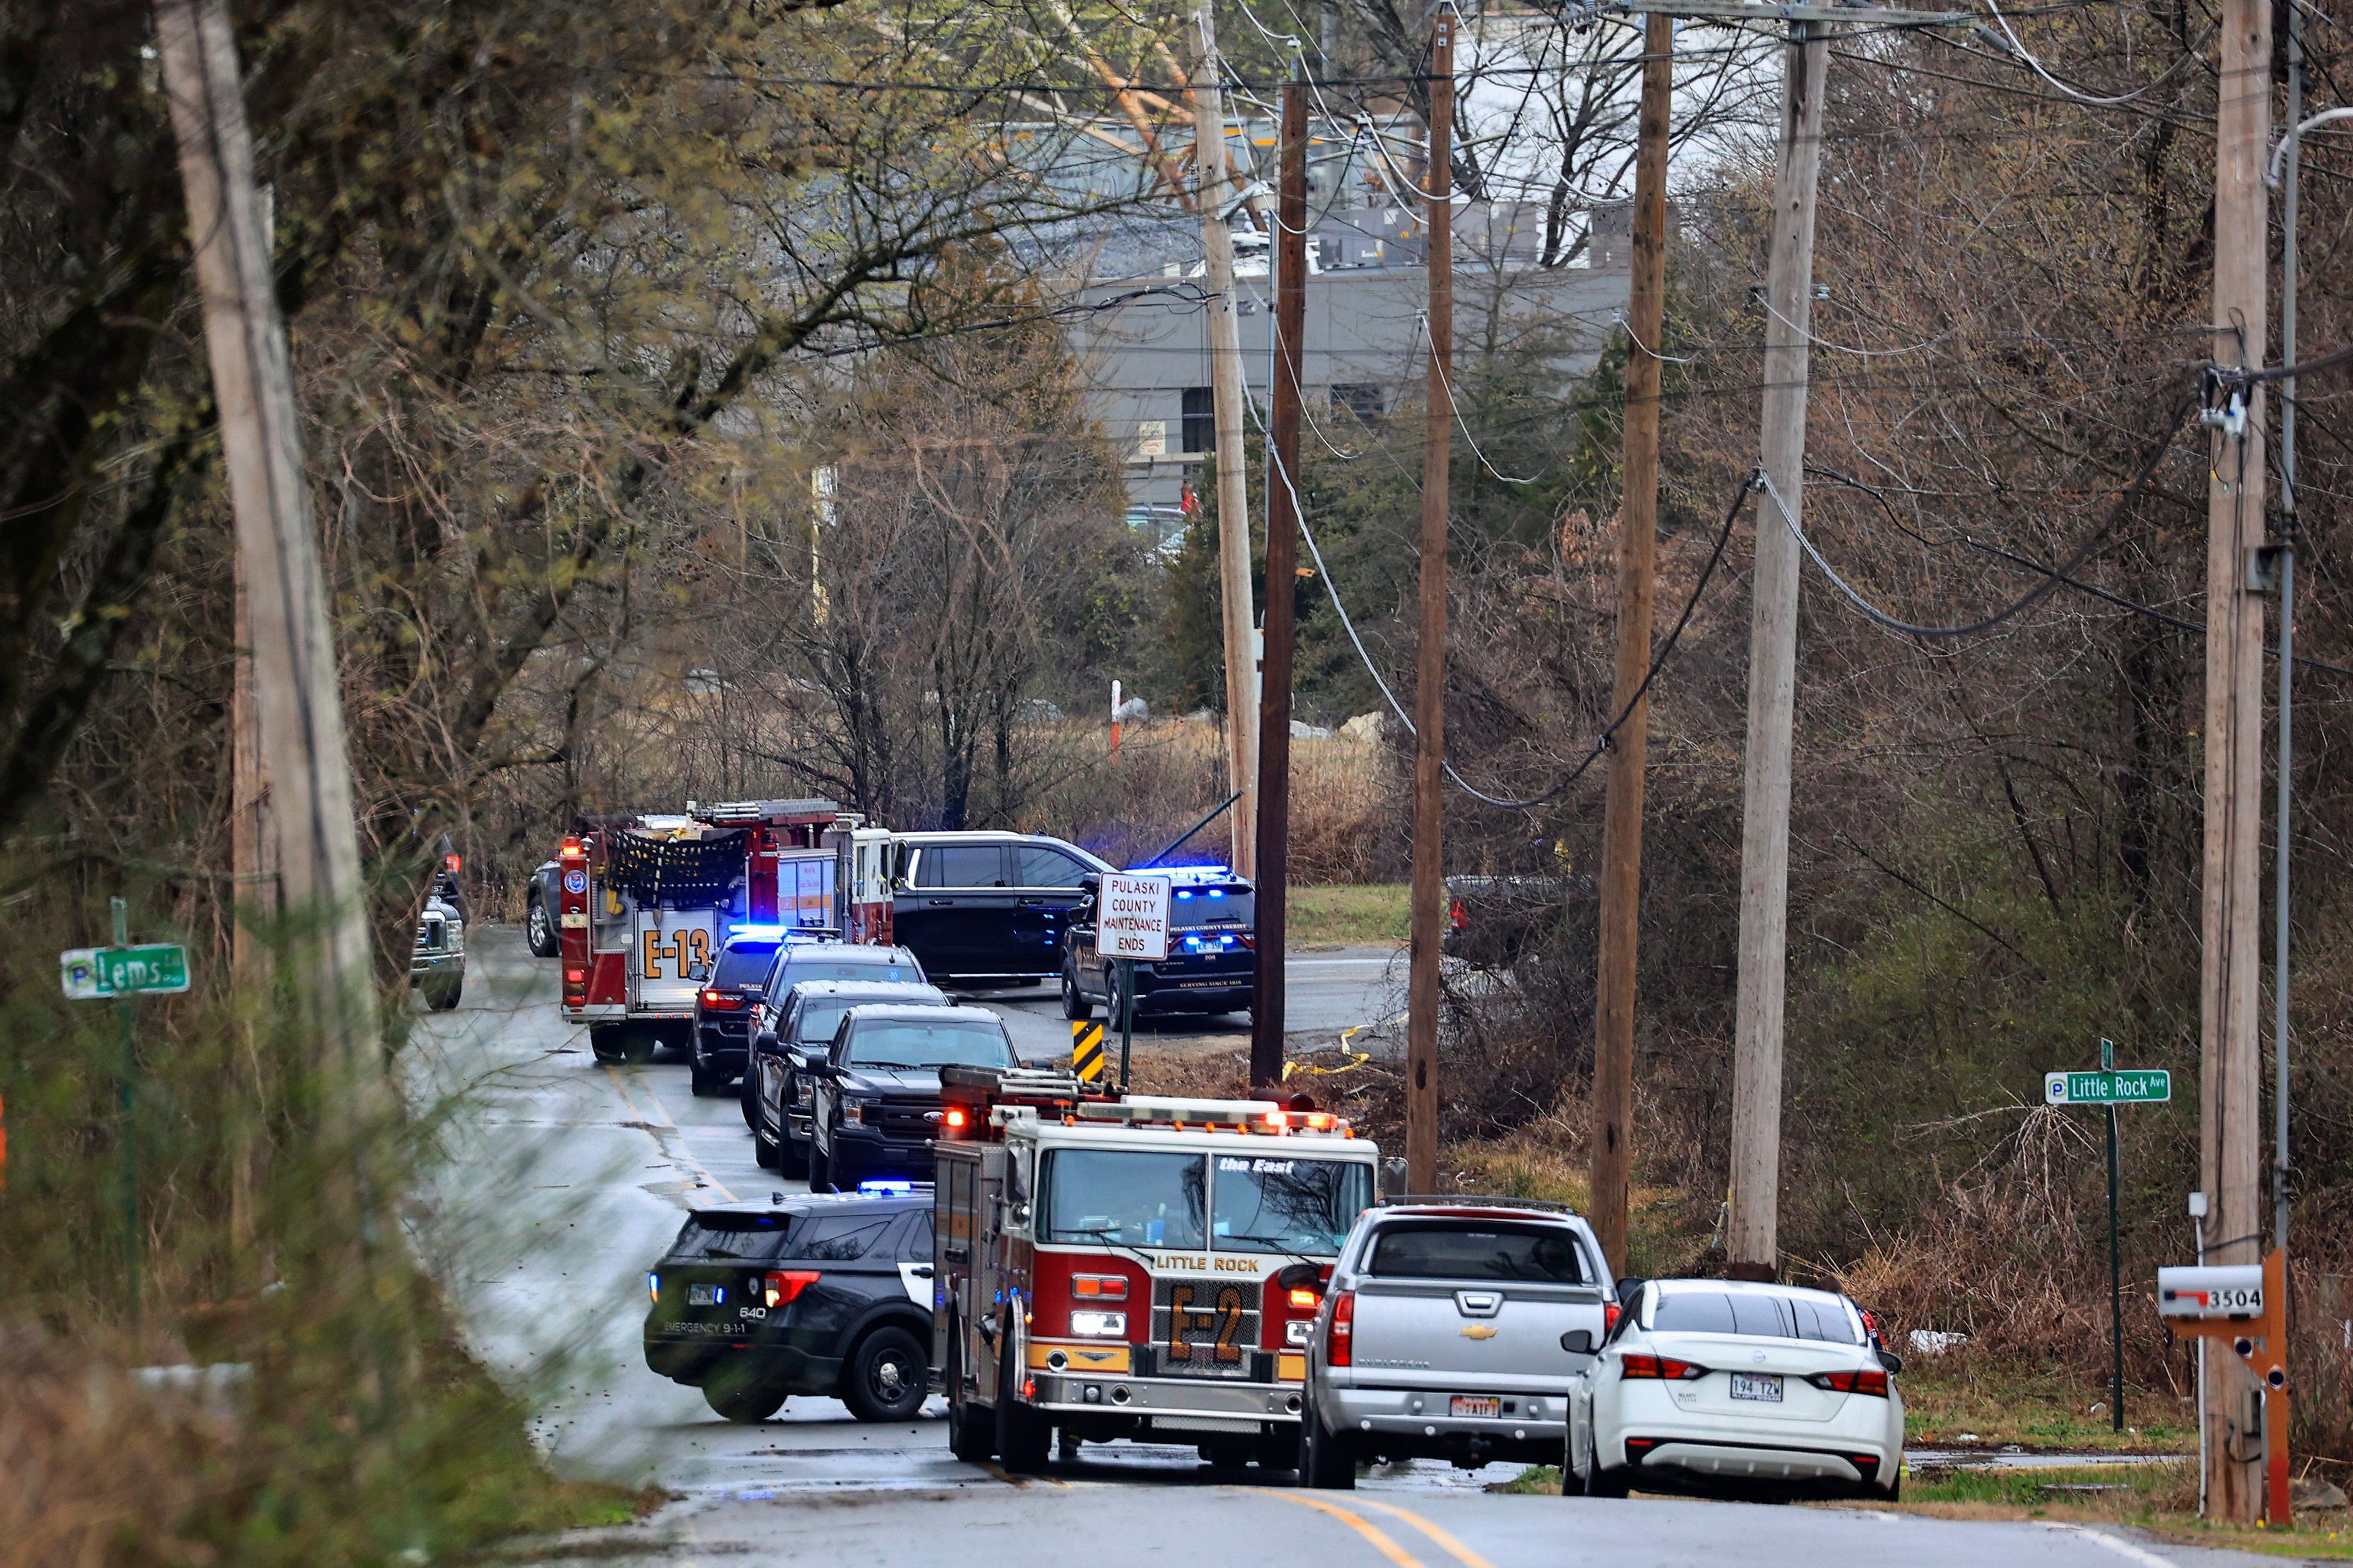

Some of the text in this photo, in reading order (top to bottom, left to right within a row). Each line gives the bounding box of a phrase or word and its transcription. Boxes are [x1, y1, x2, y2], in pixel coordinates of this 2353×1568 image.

[1112, 880, 1159, 895] PULASKI
[1112, 899, 1156, 913] COUNTY
[1104, 917, 1162, 932] MAINTENANCE
[1118, 938, 1145, 951] ENDS
[644, 929, 709, 979] E-13
[98, 956, 161, 989] Lems
[2072, 1077, 2108, 1097] Little
[2115, 1076, 2148, 1096] Rock
[2150, 1076, 2165, 1087] Ave
[1219, 1157, 1294, 1173] the East
[1156, 1255, 1259, 1272] LITTLE ROCK
[2210, 1289, 2261, 1308] 3504
[739, 1307, 766, 1318] 640
[664, 1322, 746, 1333] EMERGENCY 9-1-1
[1169, 1285, 1242, 1363] E-2
[1735, 1380, 1780, 1396] 194 TZW
